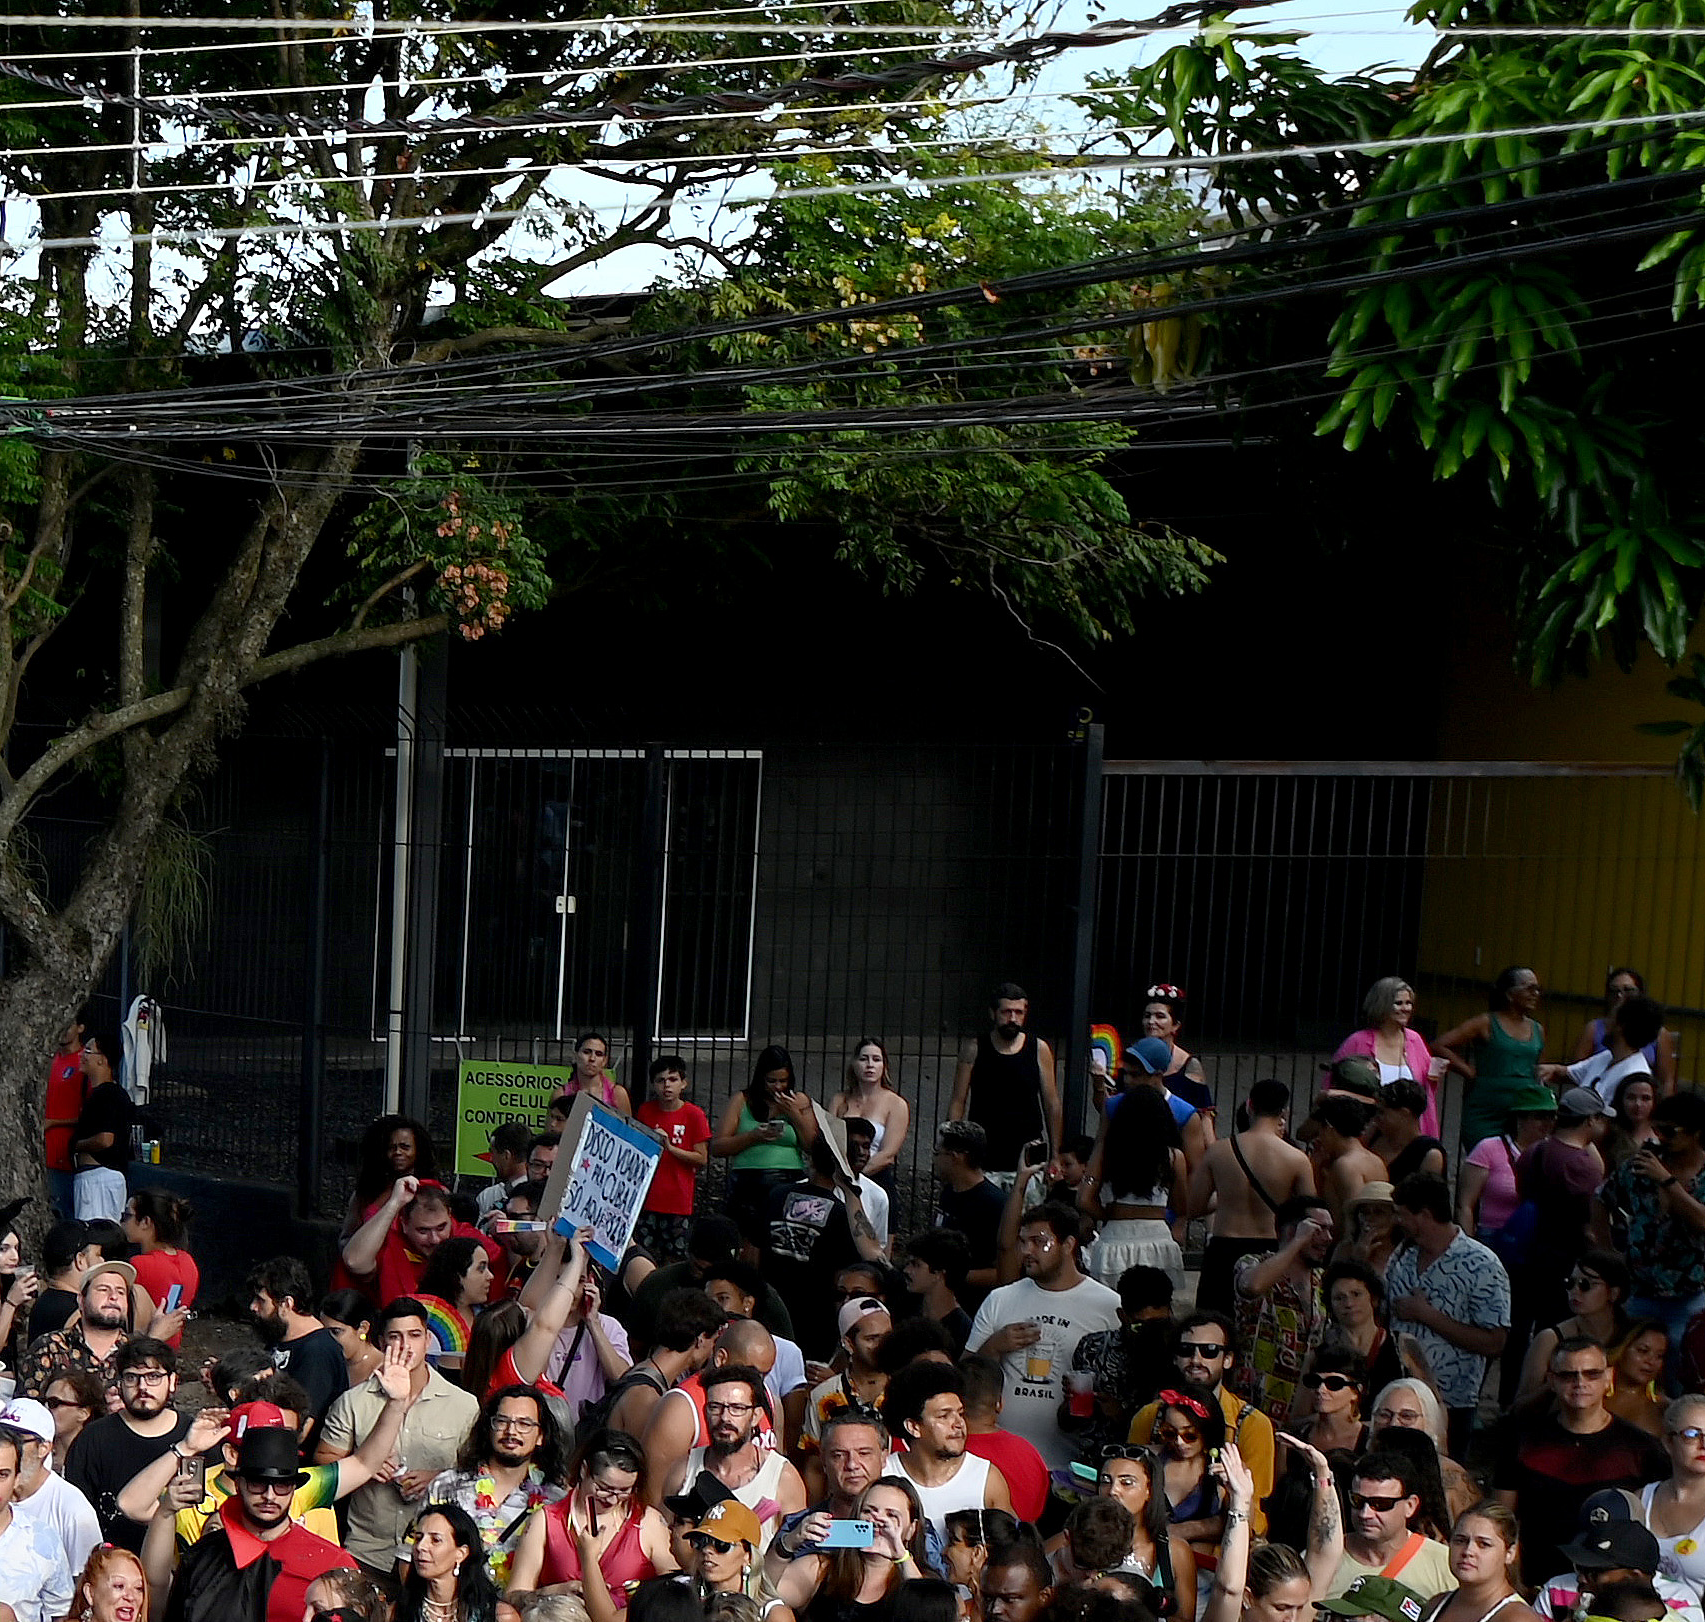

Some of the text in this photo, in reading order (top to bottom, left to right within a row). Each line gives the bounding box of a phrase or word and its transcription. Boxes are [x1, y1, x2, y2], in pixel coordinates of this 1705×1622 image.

[464, 1070, 565, 1091] ACESSÓRIOS
[498, 1092, 549, 1110] CELUL
[583, 1122, 616, 1165] DISCO
[1014, 1386, 1055, 1401] BRASIL
